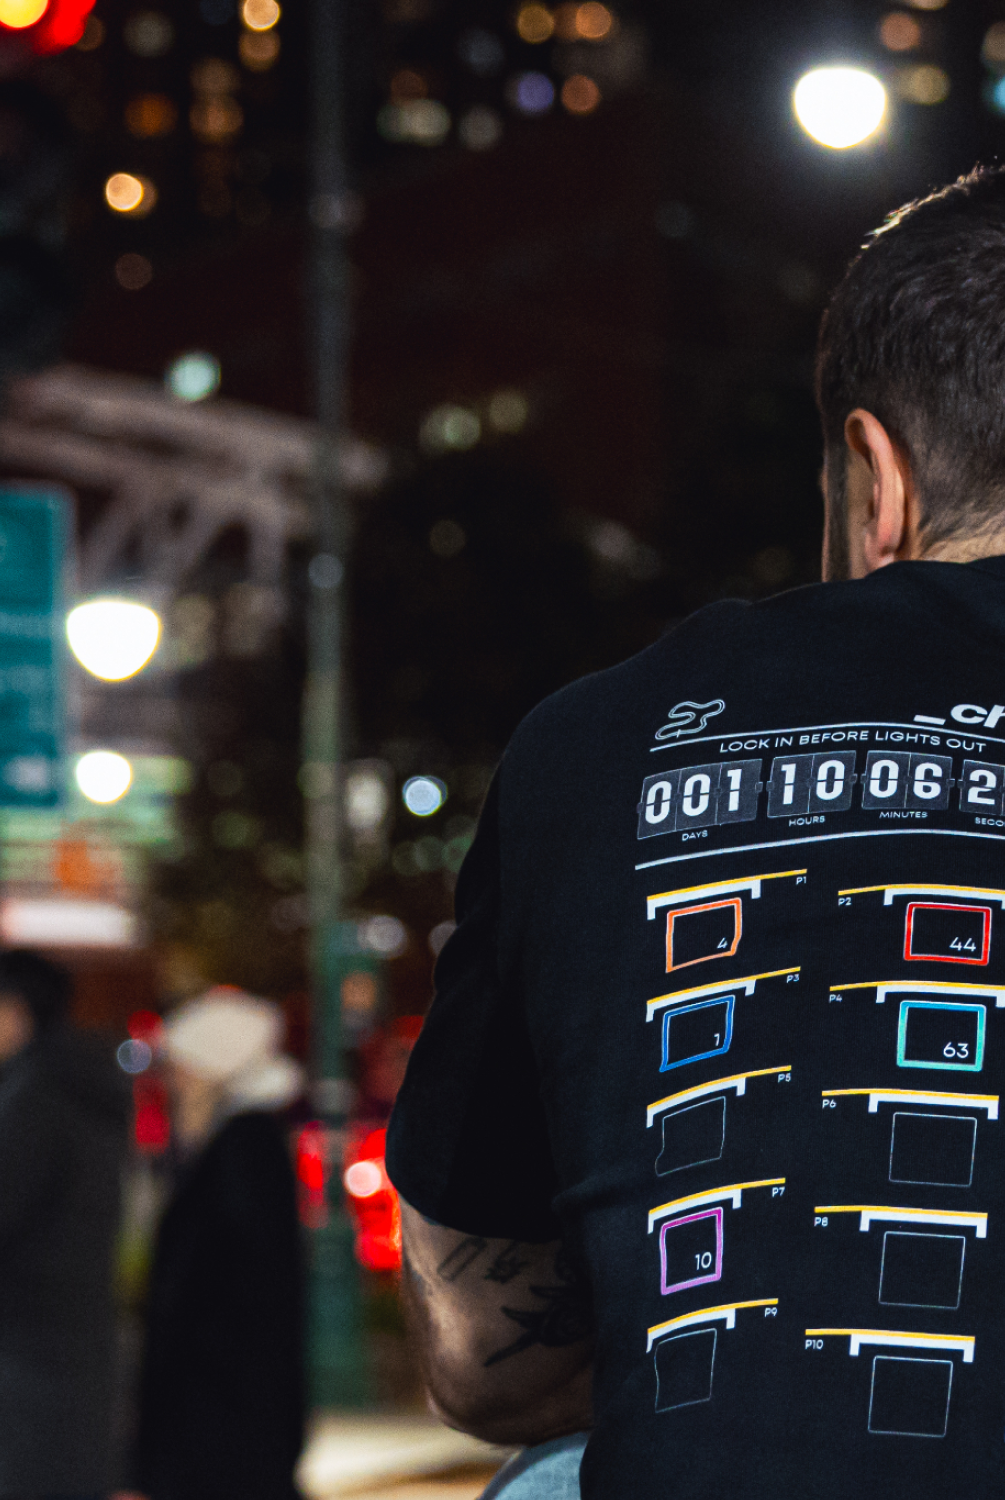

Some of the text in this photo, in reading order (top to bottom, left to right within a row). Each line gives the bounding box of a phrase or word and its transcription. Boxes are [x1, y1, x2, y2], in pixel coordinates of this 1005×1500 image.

[719, 730, 986, 753] LOCK IN BEFORE LIGHTS OUT
[782, 760, 845, 804] 10
[869, 759, 942, 799] 06
[788, 815, 825, 826] HOURS
[682, 829, 708, 841] DAYS
[796, 876, 807, 885] P1
[839, 897, 851, 906] P2
[717, 938, 728, 950] 4
[950, 937, 976, 952] 44
[786, 974, 799, 983] P3
[829, 994, 842, 1002] P4
[714, 1033, 720, 1046] 1
[943, 1043, 969, 1058] 63
[777, 1073, 791, 1083] P5
[822, 1100, 836, 1109] P6
[772, 1187, 785, 1197] P7
[815, 1217, 828, 1227] P8
[695, 1253, 711, 1269] 10
[764, 1308, 777, 1317] P9
[806, 1340, 824, 1349] P10
